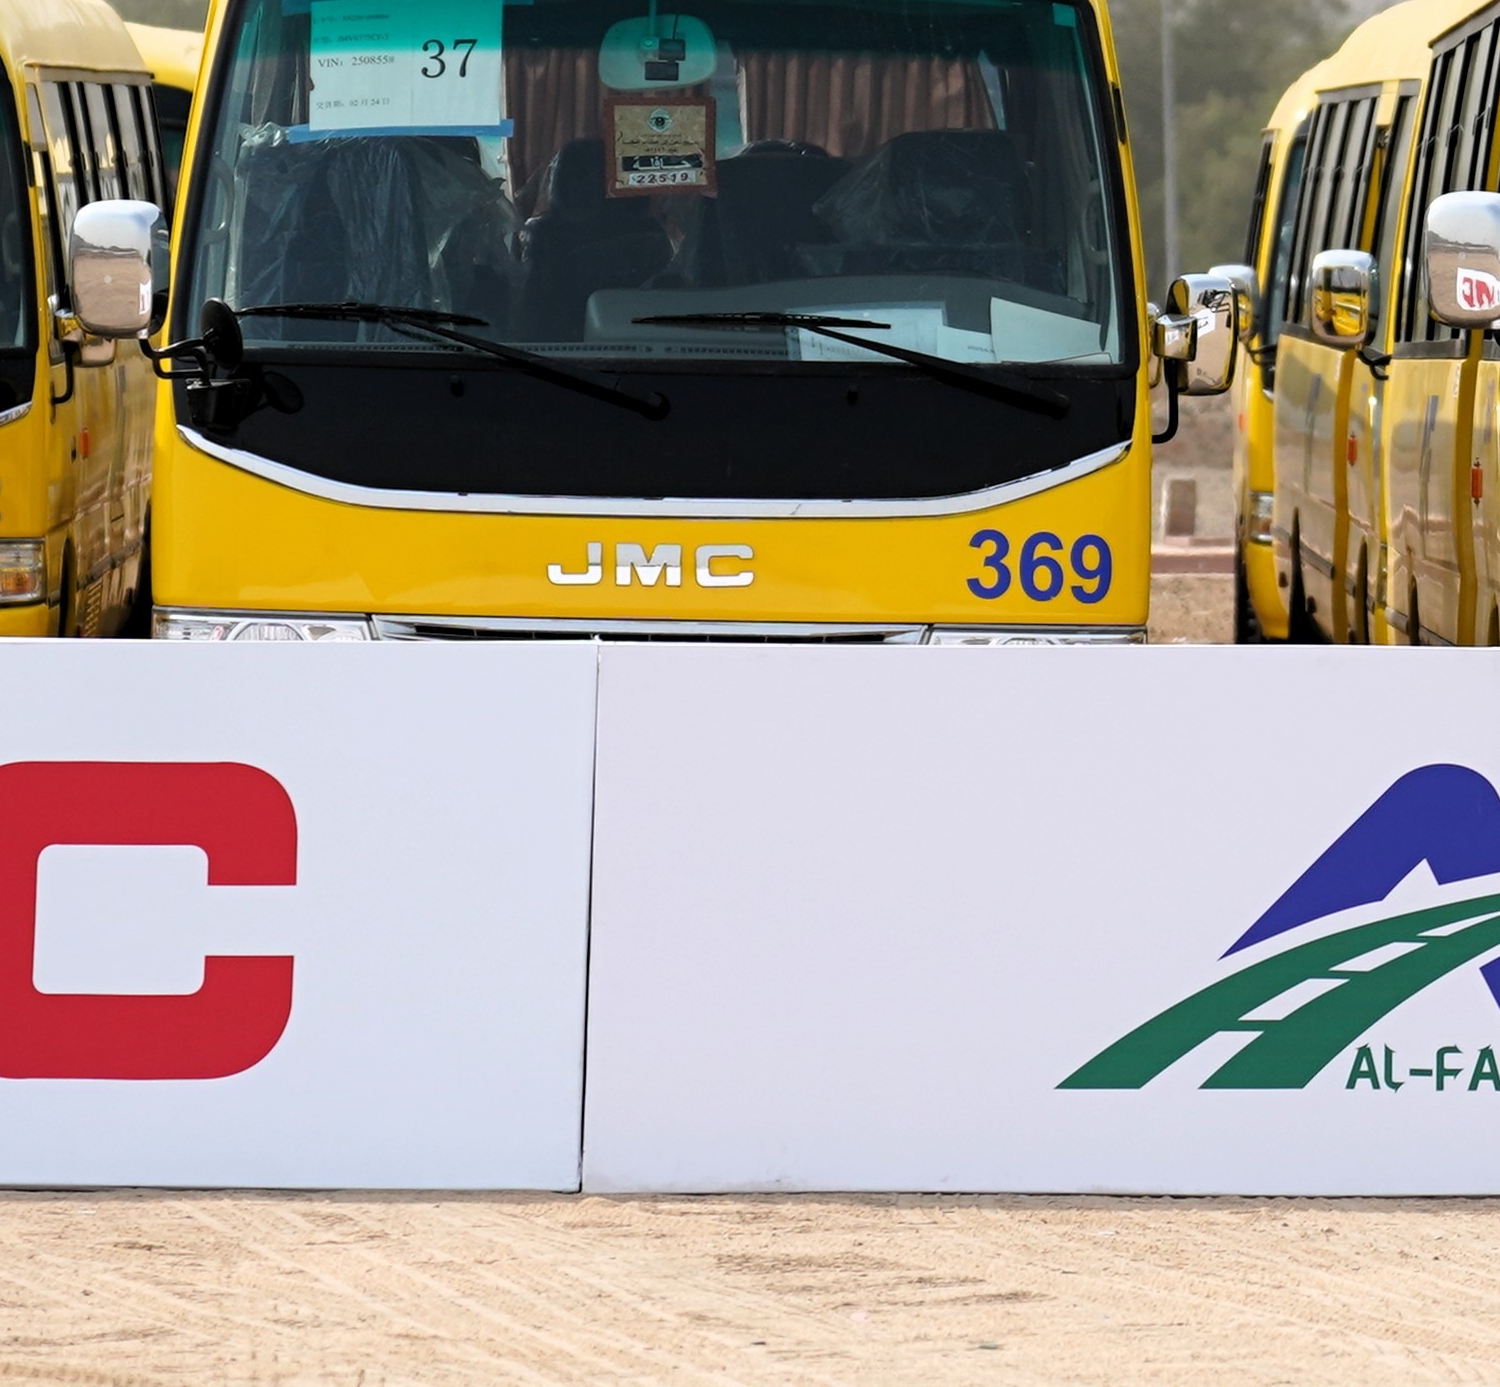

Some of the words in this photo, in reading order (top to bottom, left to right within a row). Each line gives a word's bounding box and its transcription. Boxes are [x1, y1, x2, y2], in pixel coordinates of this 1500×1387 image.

[421, 39, 478, 79] 37
[637, 172, 688, 184] 22519
[547, 541, 756, 588] JMC
[966, 529, 1113, 604] 369
